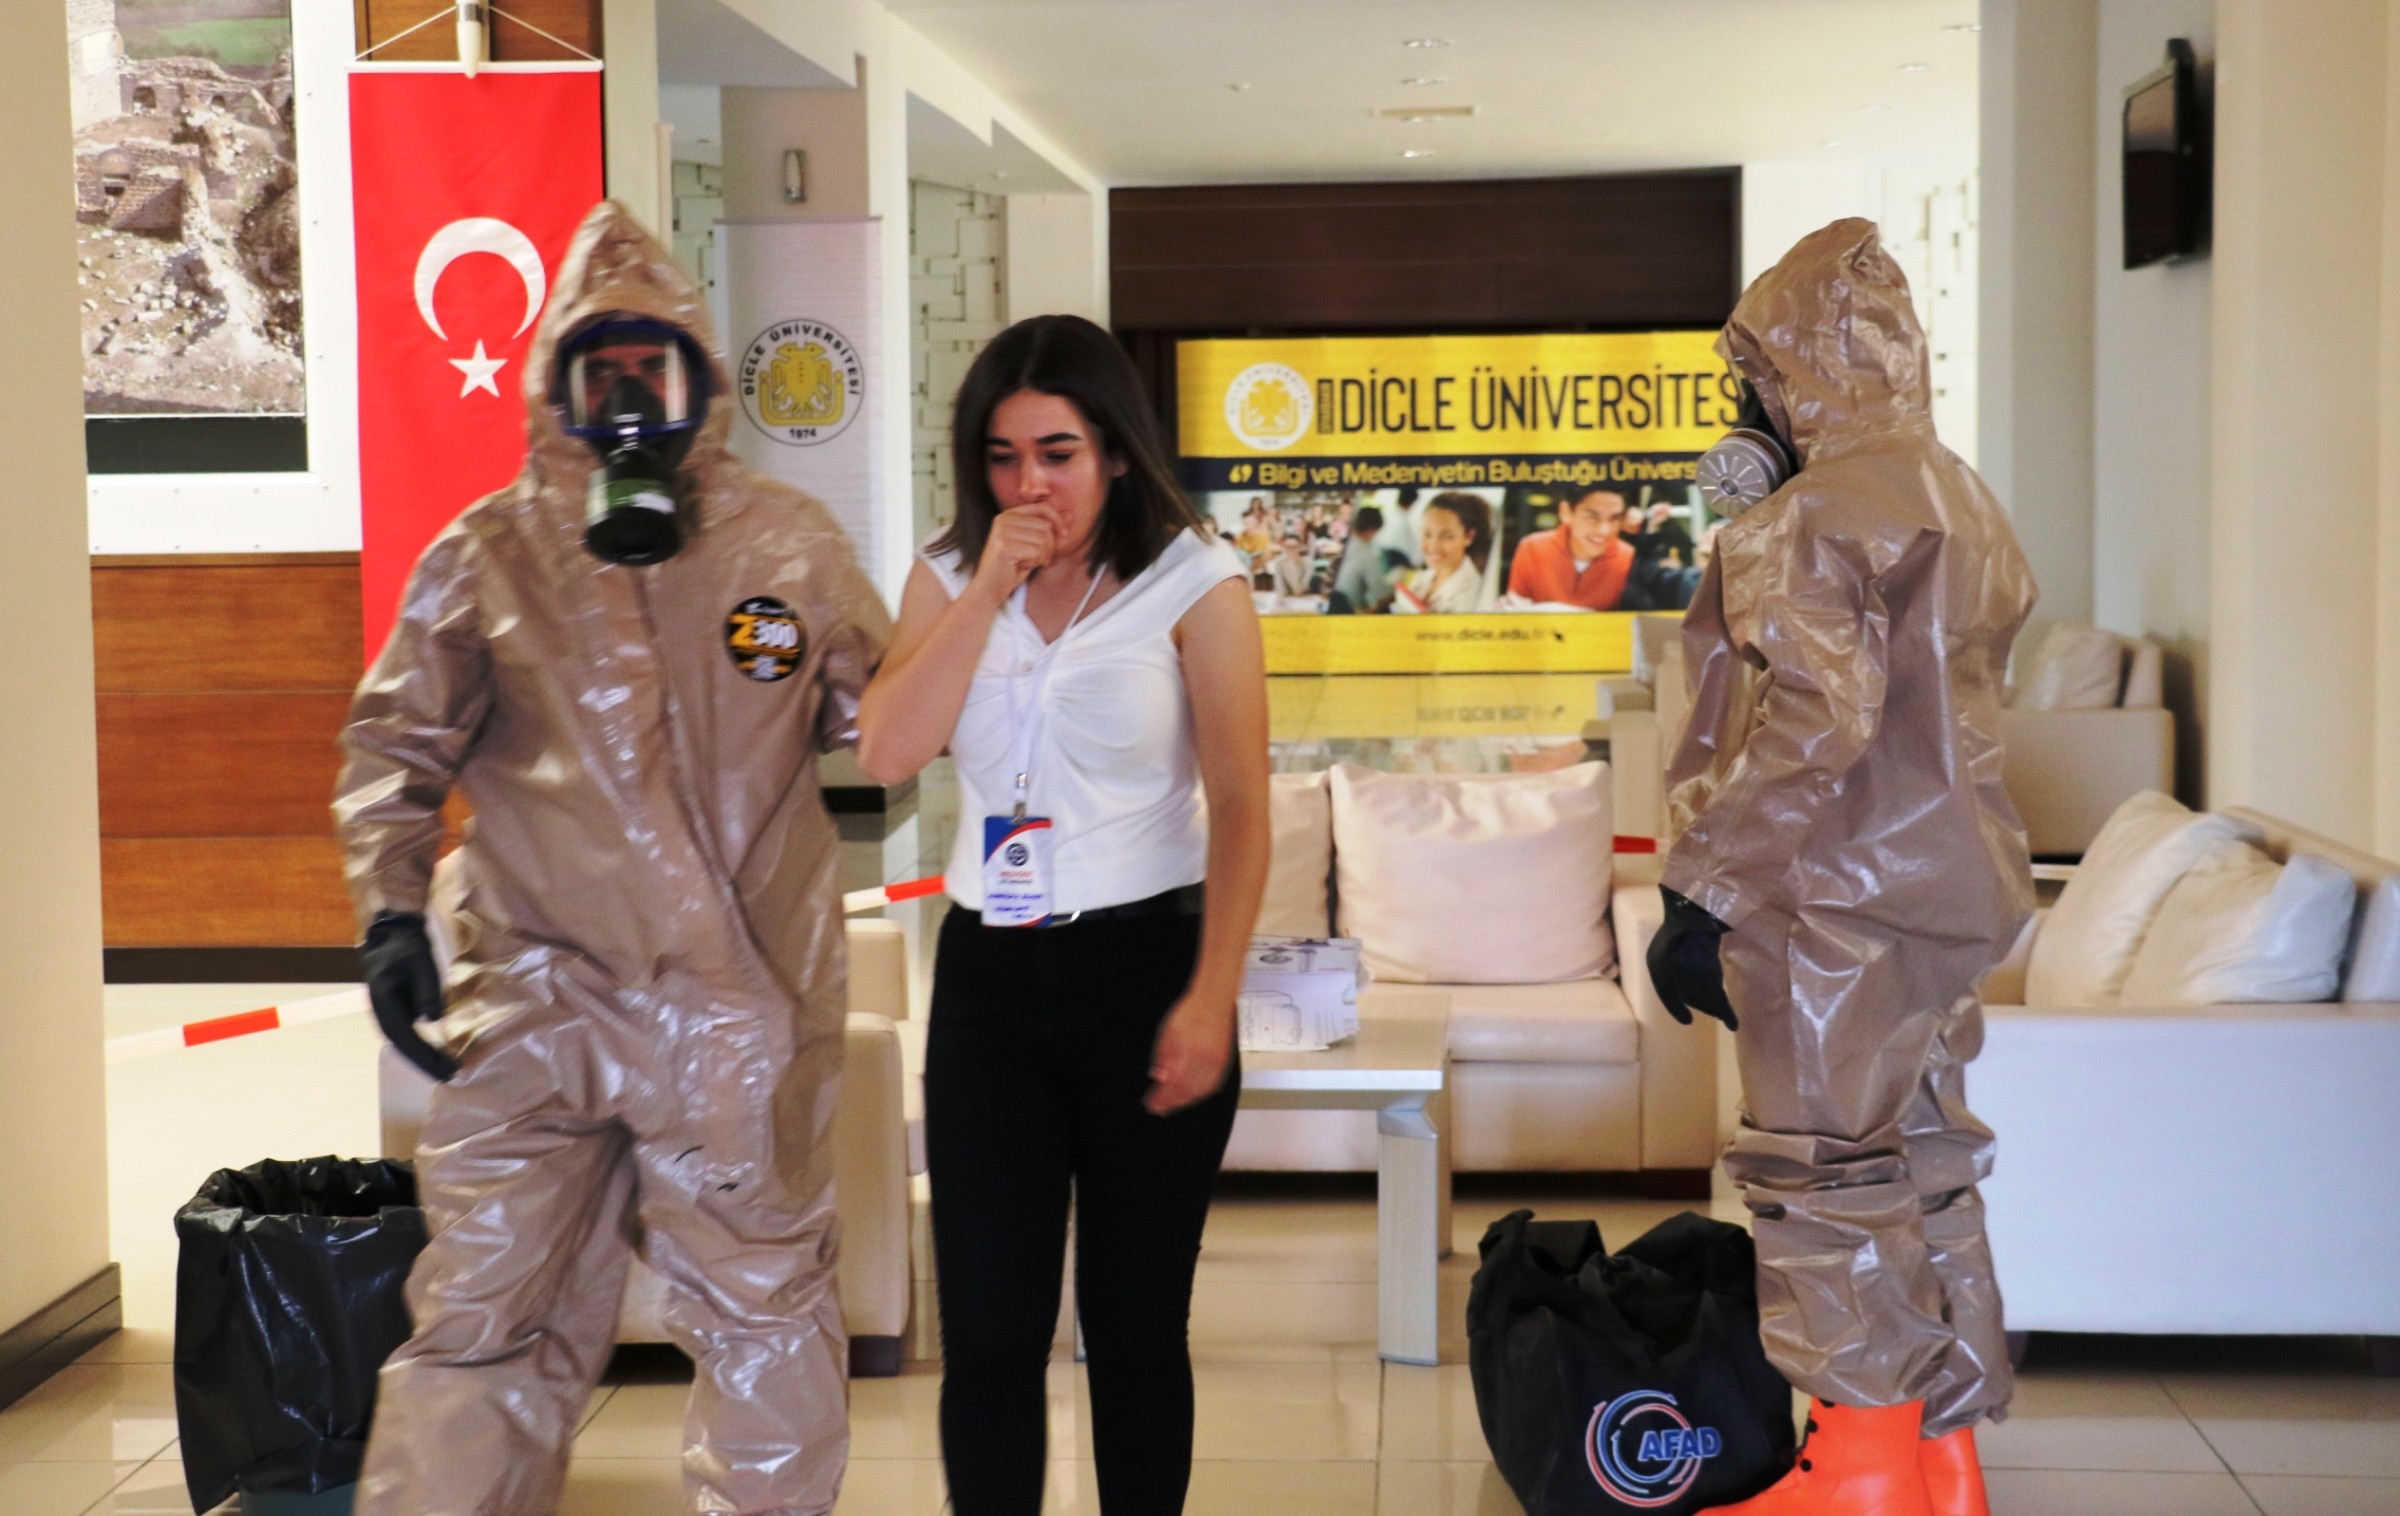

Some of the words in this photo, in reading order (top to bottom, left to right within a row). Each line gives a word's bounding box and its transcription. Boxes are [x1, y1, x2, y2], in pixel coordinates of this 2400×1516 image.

[1340, 367, 1456, 433] DİCLE
[1470, 363, 1739, 431] ÜNİVERSİTES
[789, 428, 817, 439] 1974
[1258, 462, 1307, 489] Bilgi
[1310, 467, 1339, 484] ve
[1342, 460, 1485, 488] Medeniyetin
[1488, 458, 1608, 486] Buluştuğu
[1637, 1426, 1722, 1462] AFAD
